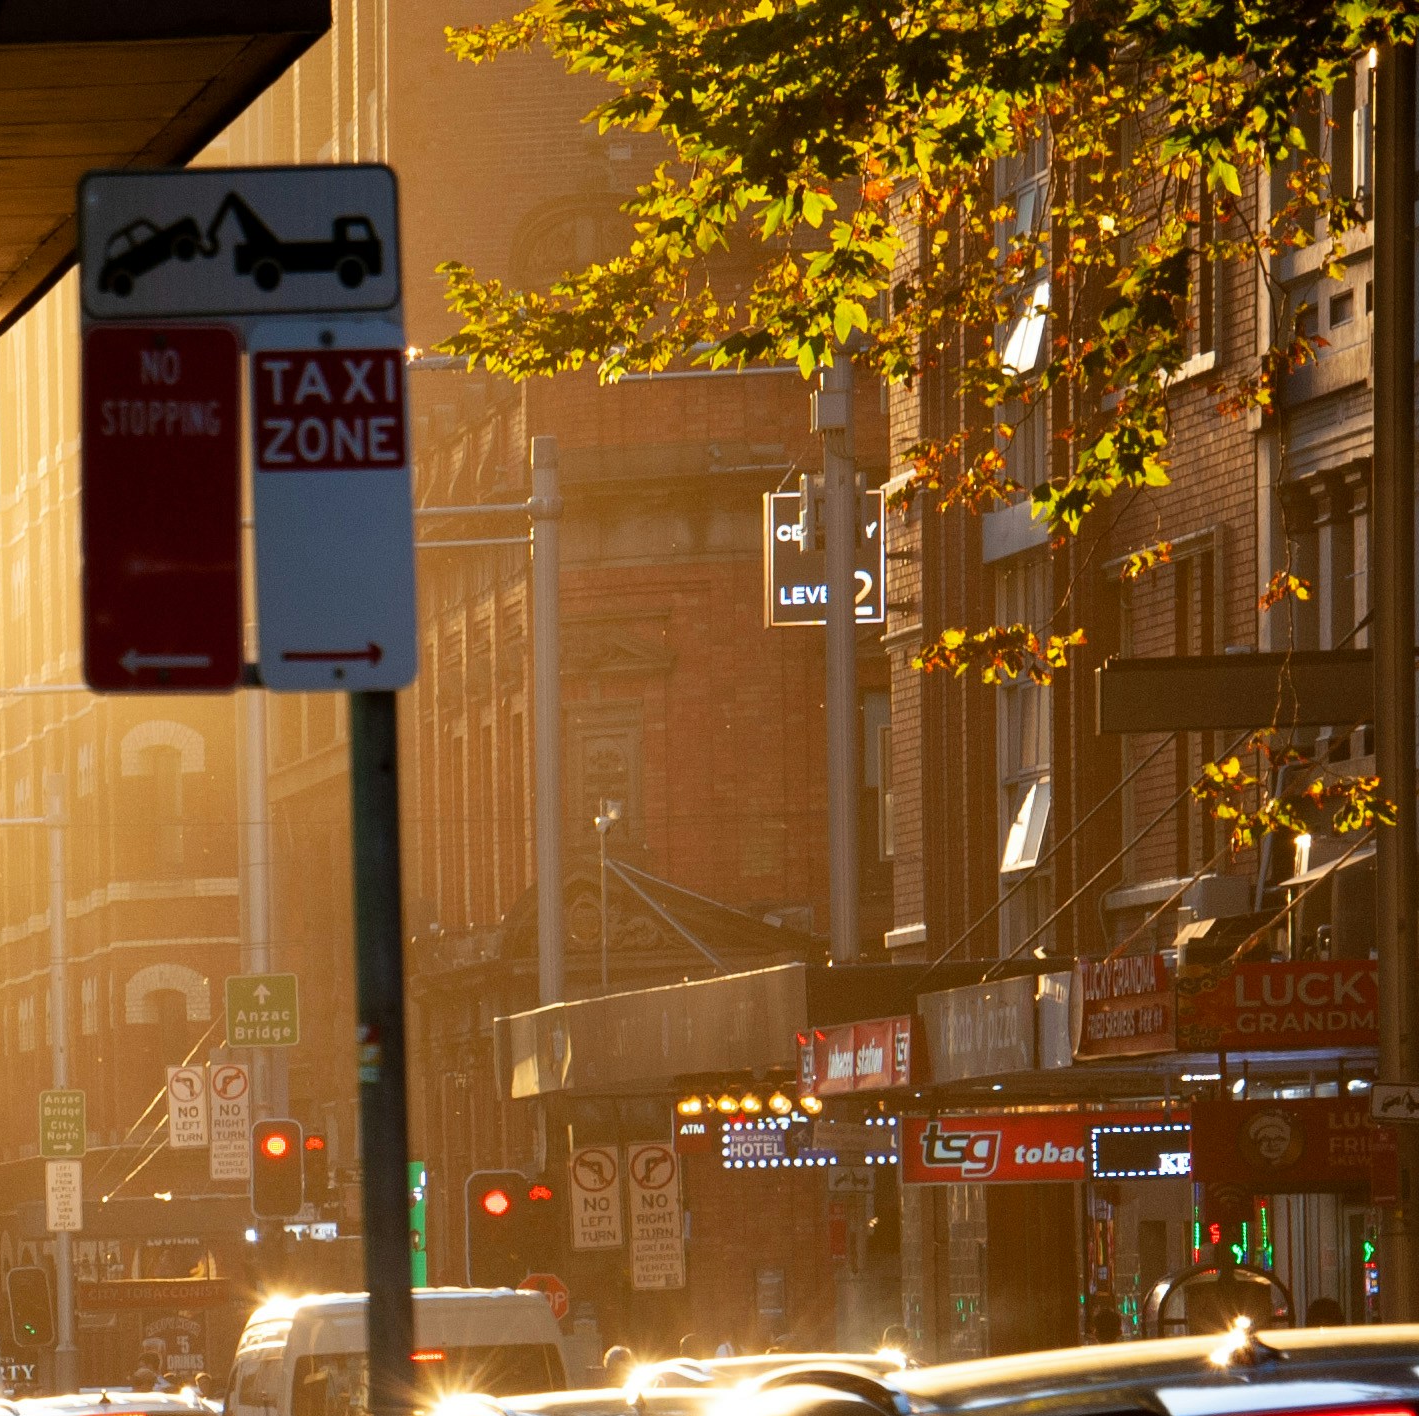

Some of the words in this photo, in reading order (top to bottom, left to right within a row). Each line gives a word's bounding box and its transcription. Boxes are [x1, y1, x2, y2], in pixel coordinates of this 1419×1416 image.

[140, 348, 181, 385] NO
[264, 358, 397, 405] TAXI
[101, 400, 223, 438] STOPPING
[264, 418, 400, 463] ZONE
[235, 1009, 290, 1023] Anzac
[1236, 1010, 1379, 1034] GRANDM
[234, 1026, 292, 1041] Bridge
[177, 1106, 199, 1119] NO
[219, 1103, 241, 1117] NO
[175, 1120, 201, 1131] LEFT
[214, 1118, 246, 1129] RIGHT
[680, 1124, 705, 1135] ATM
[176, 1132, 203, 1142] TURN
[215, 1130, 245, 1140] TURN
[729, 1143, 785, 1158] HOTEL
[583, 1197, 610, 1212] NO
[641, 1193, 668, 1209] NO
[580, 1216, 612, 1228] LEFT
[636, 1213, 674, 1225] RIGHT
[580, 1231, 616, 1242] TURN
[639, 1228, 674, 1239] TURN
